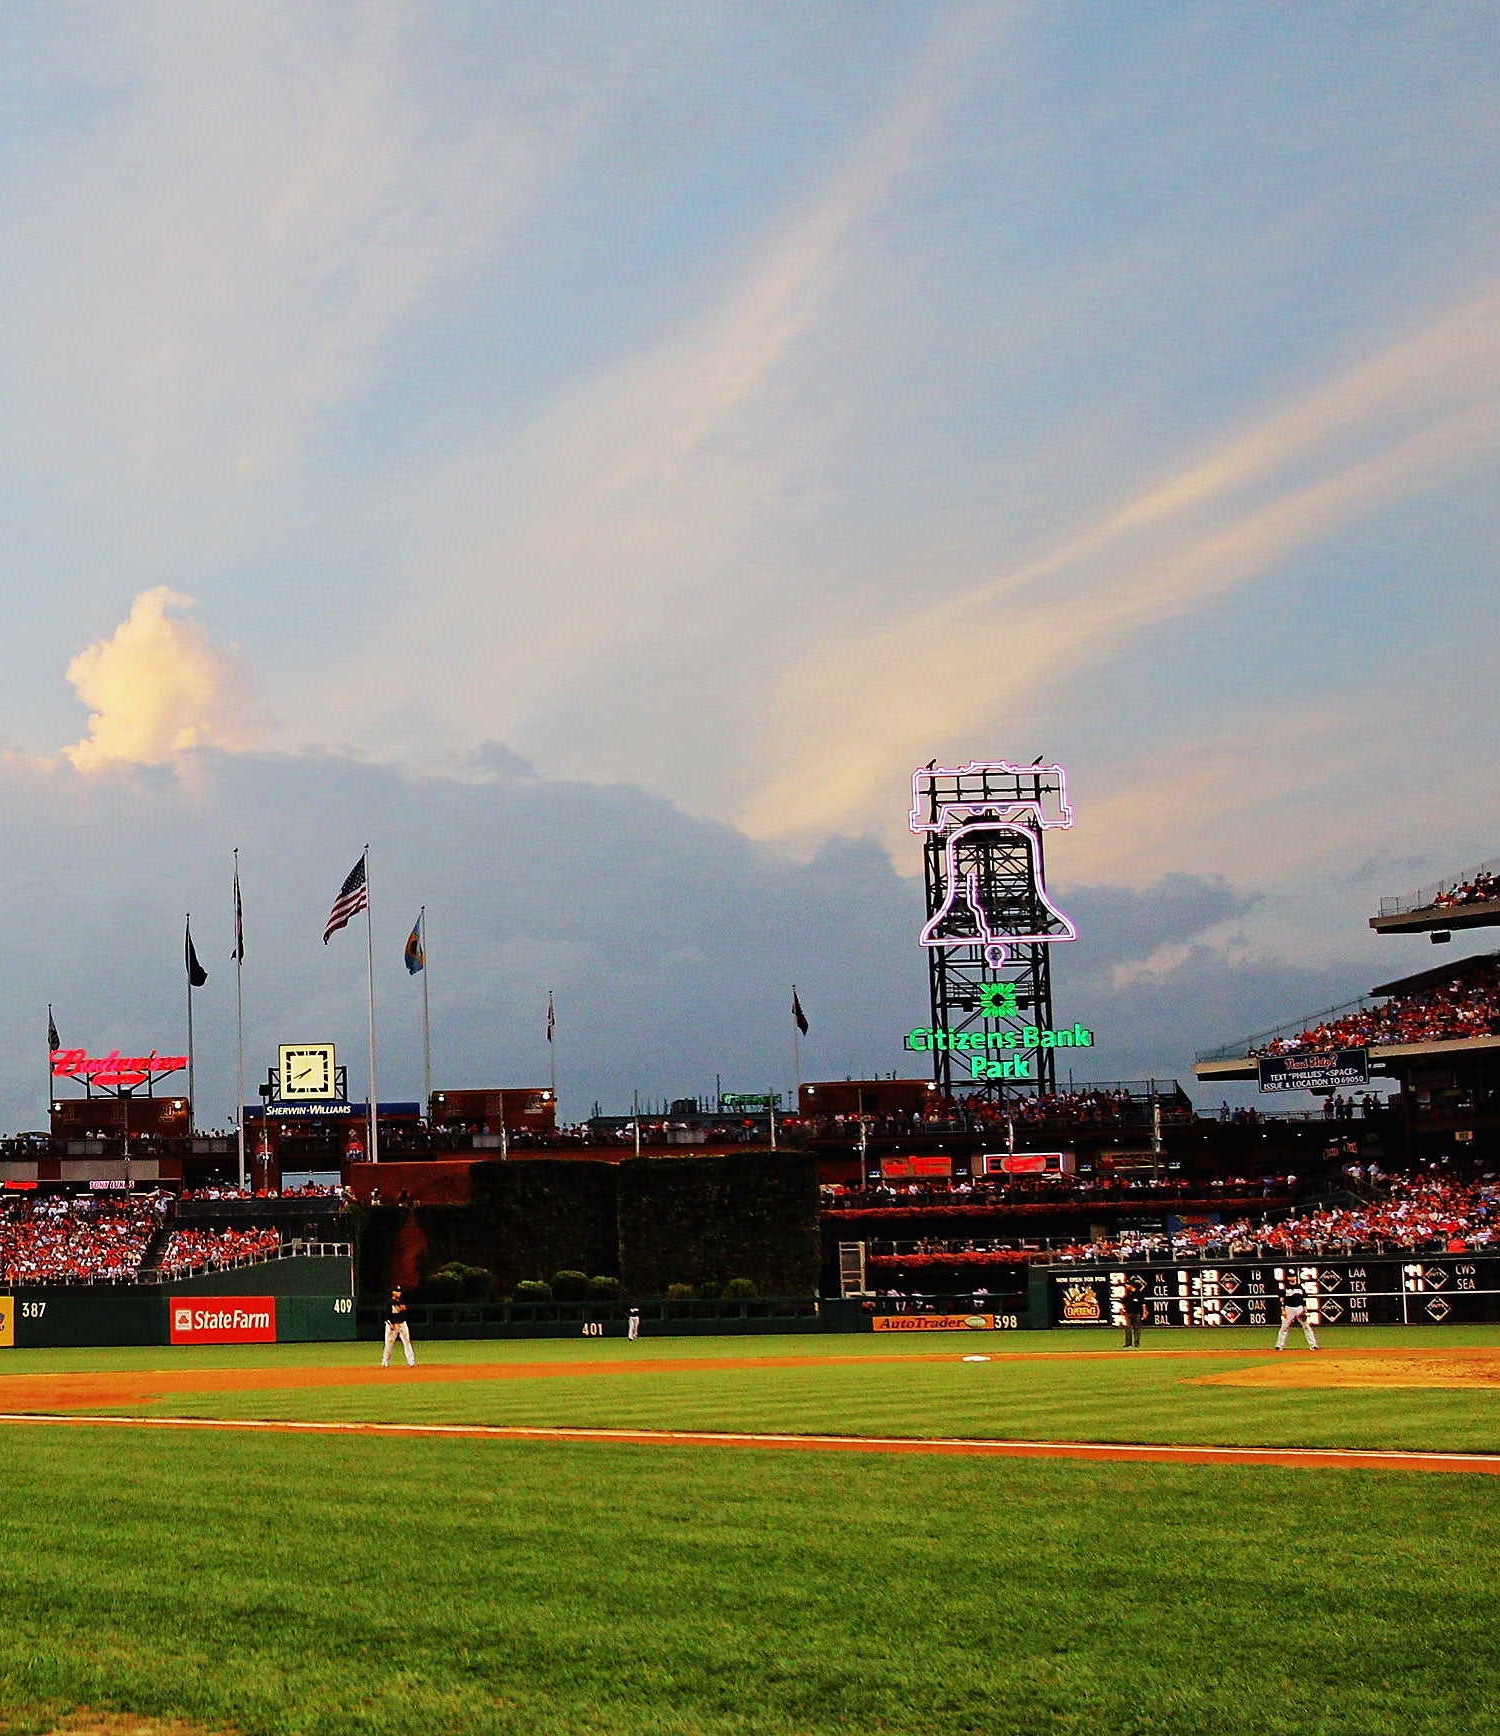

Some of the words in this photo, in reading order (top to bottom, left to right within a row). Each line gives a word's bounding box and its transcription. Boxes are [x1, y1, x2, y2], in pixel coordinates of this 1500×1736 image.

[908, 1027, 1018, 1051] Citizens
[1021, 1022, 1092, 1048] Bank
[49, 1048, 189, 1077] Budweiser
[969, 1053, 1031, 1079] Park
[1284, 1058, 1309, 1070] Need
[1270, 1073, 1288, 1082] TEXT
[1292, 1078, 1329, 1088] LOCATION
[89, 1180, 110, 1190] TONY
[1348, 1267, 1367, 1278] LAA
[1455, 1263, 1476, 1275] CWS
[1155, 1273, 1166, 1283] KC
[1251, 1270, 1262, 1280] TB
[1248, 1284, 1265, 1294] TOR
[1350, 1281, 1367, 1292] TEX
[1457, 1279, 1476, 1290] SEA
[1153, 1285, 1168, 1297] CLE
[334, 1298, 353, 1314] 409
[1153, 1301, 1169, 1312] NYY
[1248, 1300, 1267, 1311] OAK
[1350, 1297, 1367, 1309] DET
[22, 1302, 47, 1318] 387
[994, 1315, 1018, 1328] 398
[1155, 1314, 1170, 1325] BAL
[1250, 1313, 1266, 1324] BOS
[1351, 1312, 1369, 1323] MIN
[880, 1317, 964, 1330] AutoTrader
[582, 1322, 603, 1337] 401
